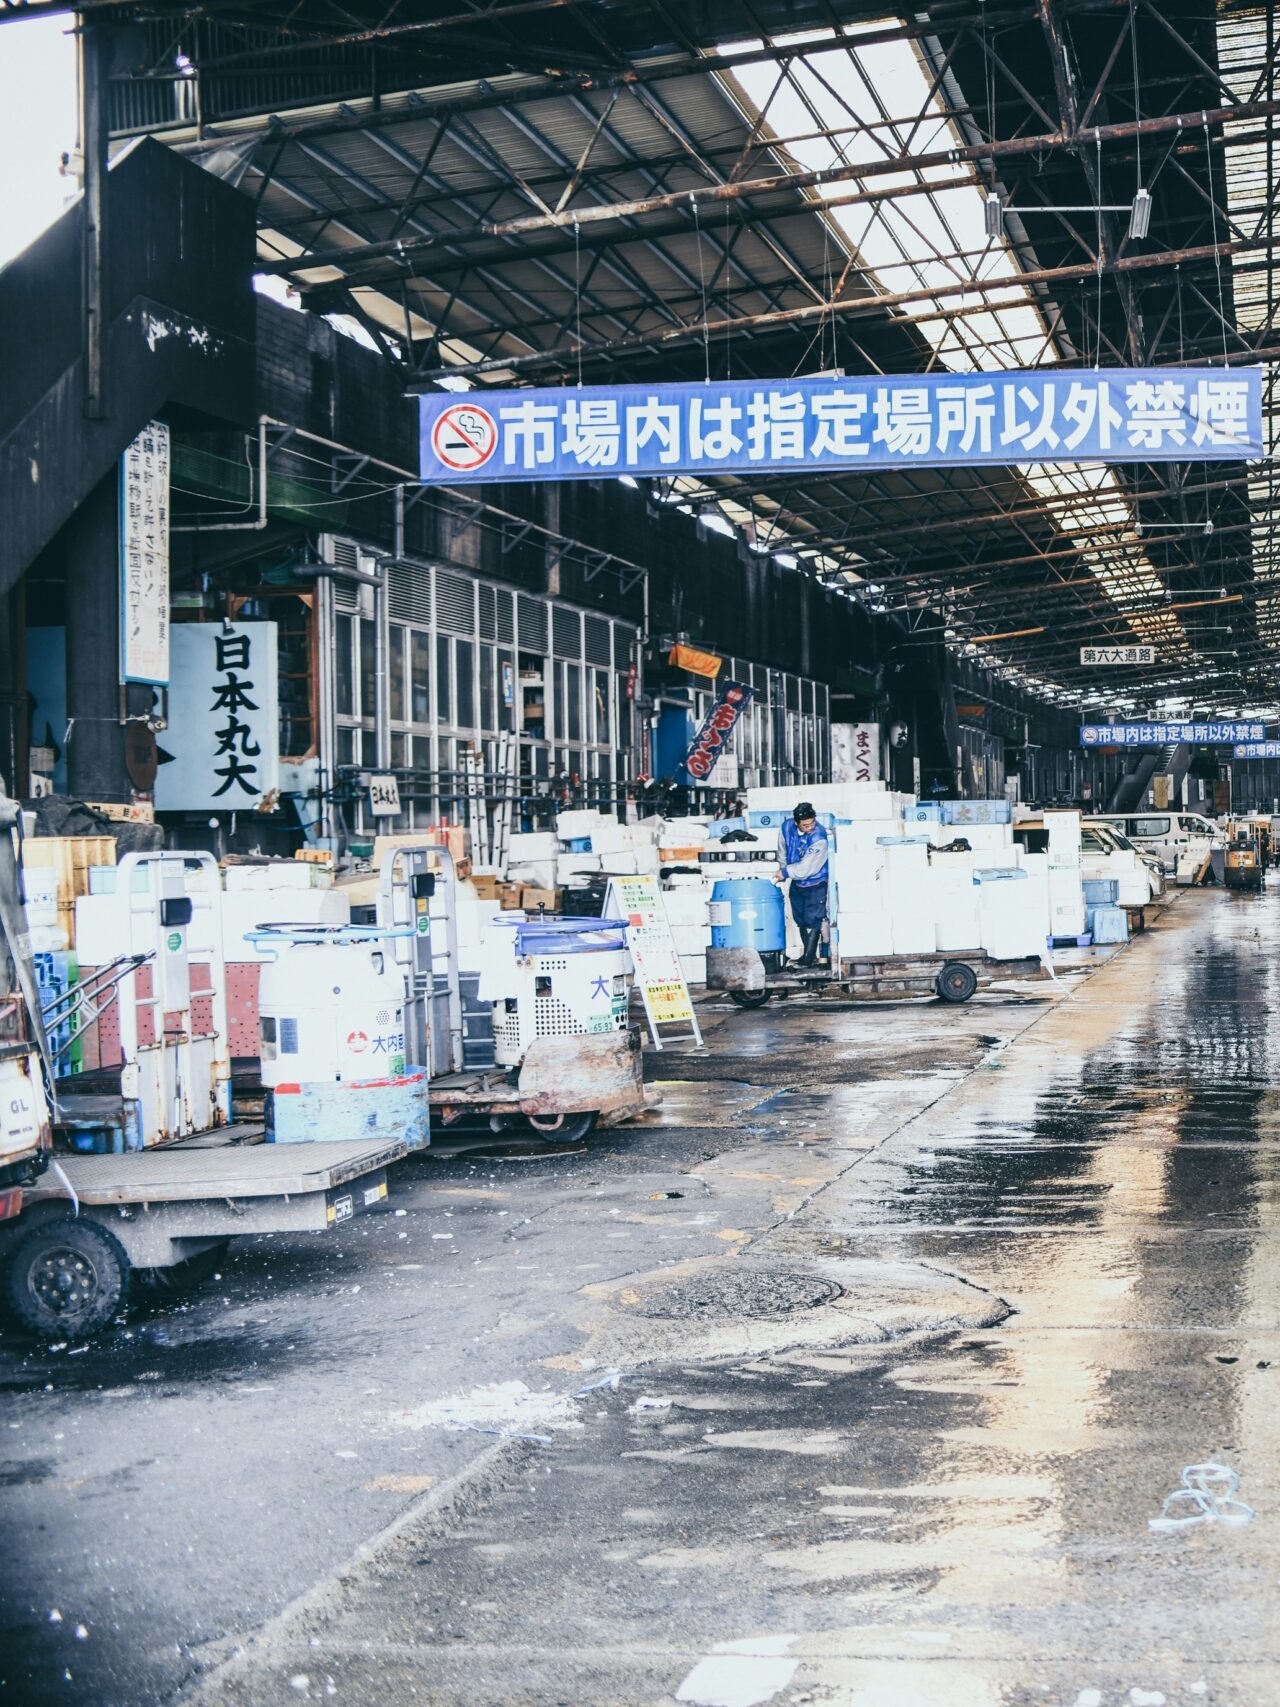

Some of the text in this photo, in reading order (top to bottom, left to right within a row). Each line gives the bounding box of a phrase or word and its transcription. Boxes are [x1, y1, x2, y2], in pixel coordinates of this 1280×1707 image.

[499, 380, 1251, 468] 市場内は指定場所以外禁煙
[1083, 648, 1151, 662] 第六大通路
[209, 634, 262, 797] 日本丸大
[1149, 711, 1193, 720] 第五大通路
[686, 703, 738, 778] まぐろ
[1098, 725, 1264, 742] 市場内は指定場所以外禁煙
[856, 731, 871, 781] まぐろ
[590, 975, 610, 999] 大
[10, 1099, 29, 1114] GL
